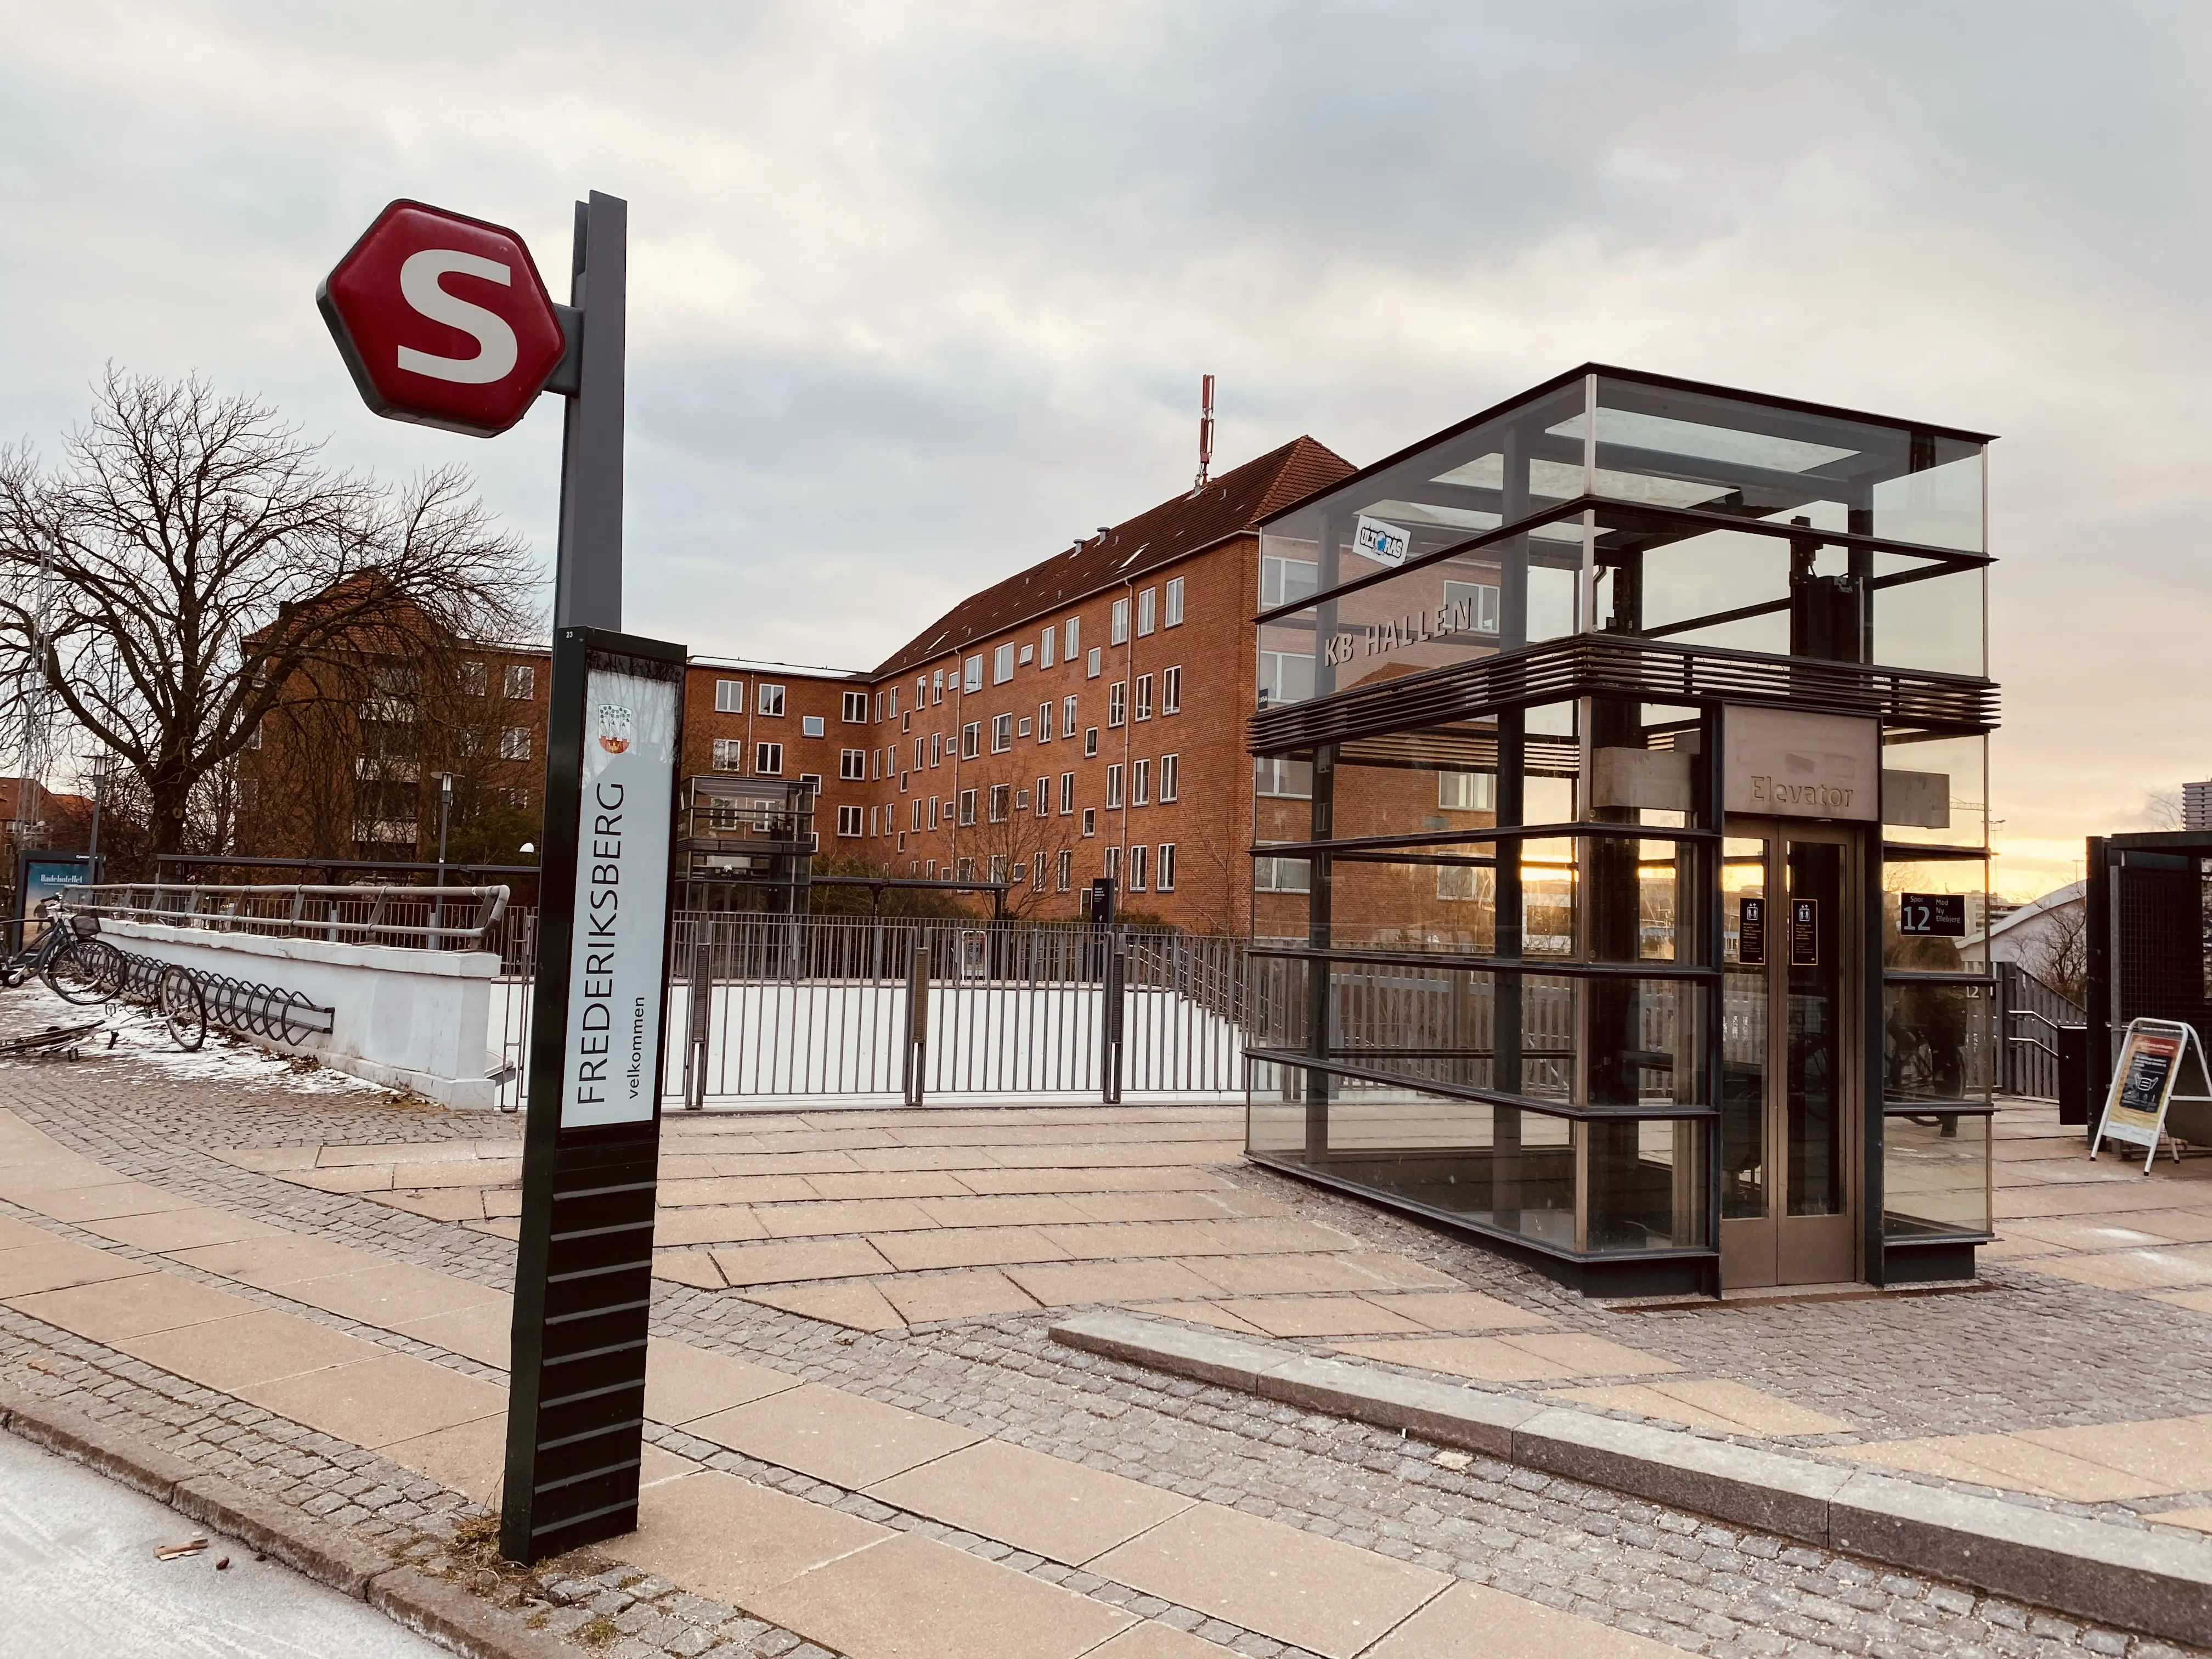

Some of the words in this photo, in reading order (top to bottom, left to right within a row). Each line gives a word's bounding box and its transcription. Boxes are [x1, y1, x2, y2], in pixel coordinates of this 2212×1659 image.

[398, 249, 518, 384] S
[1325, 633, 1353, 667] KB
[1365, 597, 1471, 656] HALLEN
[1751, 776, 1854, 807] Elevator
[578, 783, 624, 1104] FREDERIKSBERG
[1904, 906, 1931, 930] 12
[1936, 915, 1961, 923] Ellebjerg
[629, 996, 645, 1099] velkommen
